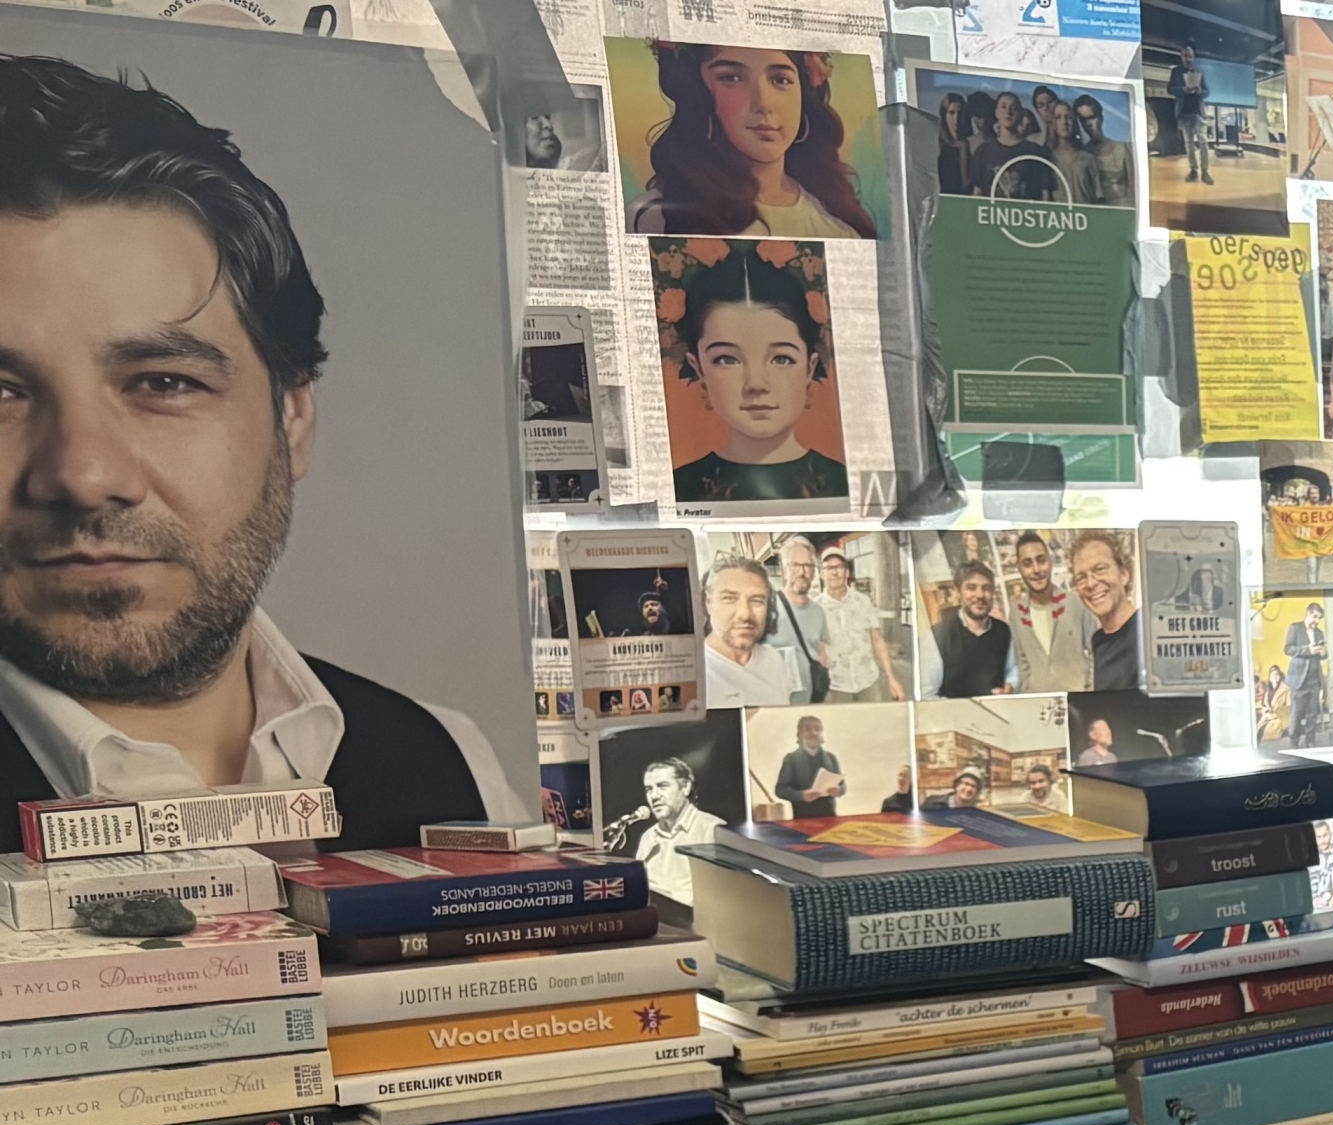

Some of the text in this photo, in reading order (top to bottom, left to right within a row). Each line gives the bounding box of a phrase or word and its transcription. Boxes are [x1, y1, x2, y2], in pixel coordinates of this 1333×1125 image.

[977, 205, 1088, 231] EINDSTAND
[1168, 617, 1221, 632] HET GROTE
[1156, 642, 1232, 659] NACHTKWARTET
[101, 814, 112, 846] contains
[111, 814, 124, 844] product
[123, 820, 133, 837] This
[1211, 853, 1256, 872] troost
[441, 879, 573, 899] ENGELS-NEDERLANDS
[431, 894, 573, 916] BEELDWOORDENBOEK
[1216, 900, 1247, 918] rust
[524, 925, 556, 941] MET
[858, 910, 969, 935] SPECTRUM
[465, 929, 521, 946] REVIUS
[858, 922, 1002, 952] CITATENBOEK
[13, 956, 250, 996] TAYLOR Daringham Hall
[1180, 956, 1233, 975] ZEEUWSE
[399, 985, 453, 1006] JUDITH
[458, 975, 539, 1000] HERZBERG
[548, 973, 578, 990] Doen
[580, 973, 594, 986] en
[948, 1002, 965, 1017] de
[1160, 993, 1223, 1014] Nederlands
[22, 1015, 257, 1058] TAYLOR Daringham Hall
[428, 1010, 615, 1050] Woordenboek
[655, 1045, 706, 1062] LIZE SPIT
[378, 1069, 503, 1096] DE EERLIJKE VINDER
[34, 1073, 267, 1119] TAYLOR Daringham Hall
